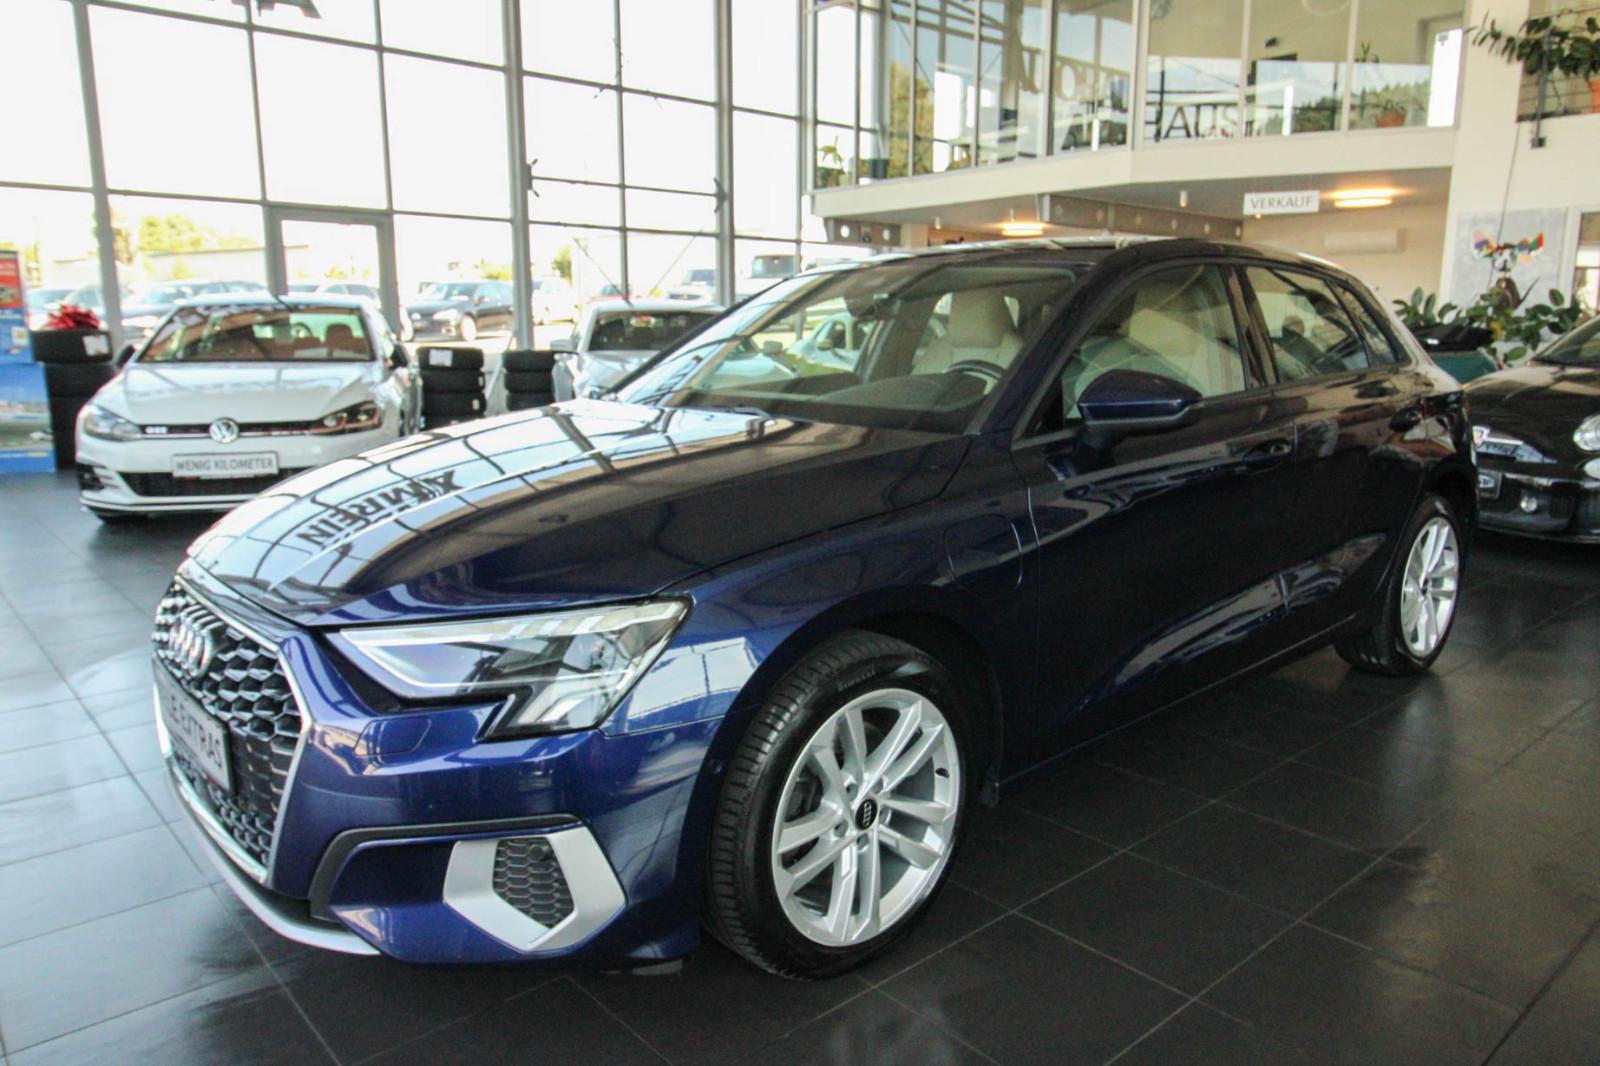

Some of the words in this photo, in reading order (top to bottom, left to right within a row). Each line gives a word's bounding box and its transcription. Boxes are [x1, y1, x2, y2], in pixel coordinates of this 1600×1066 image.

[1249, 194, 1313, 210] VERKAUF
[176, 460, 210, 470] WENIG
[213, 457, 273, 470] KILOMETER
